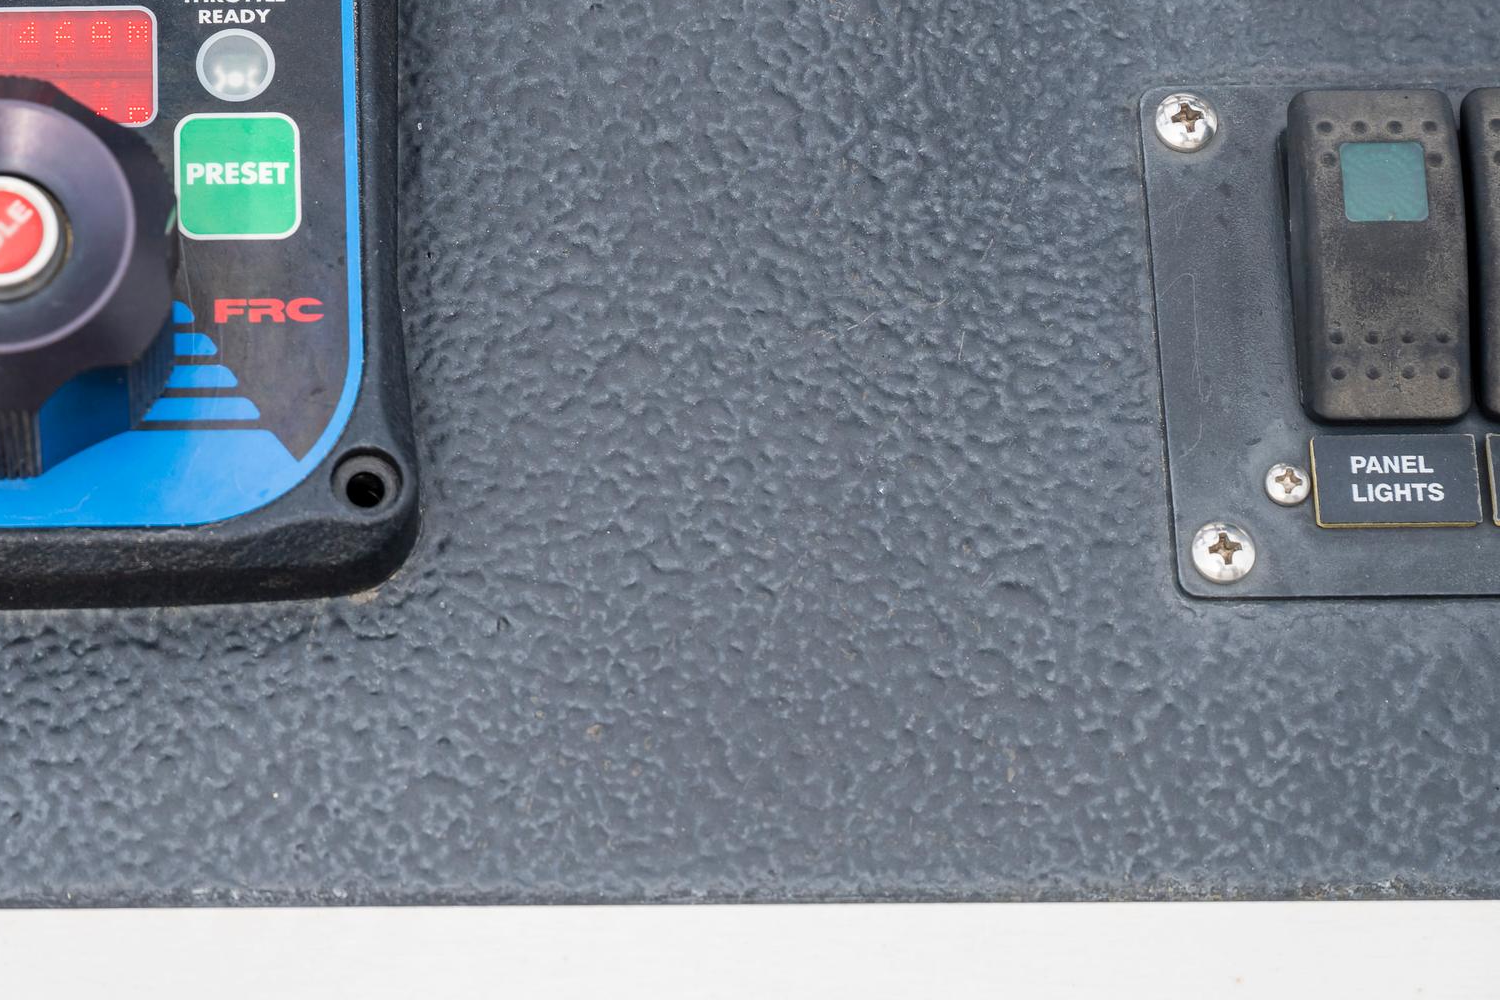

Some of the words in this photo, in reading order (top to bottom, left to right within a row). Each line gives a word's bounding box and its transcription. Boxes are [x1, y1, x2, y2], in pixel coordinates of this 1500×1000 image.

[198, 7, 271, 24] READY
[186, 161, 290, 186] PRESET
[213, 299, 324, 324] FRC
[1350, 455, 1434, 474] PANEL
[1352, 482, 1444, 502] LIGHTS
